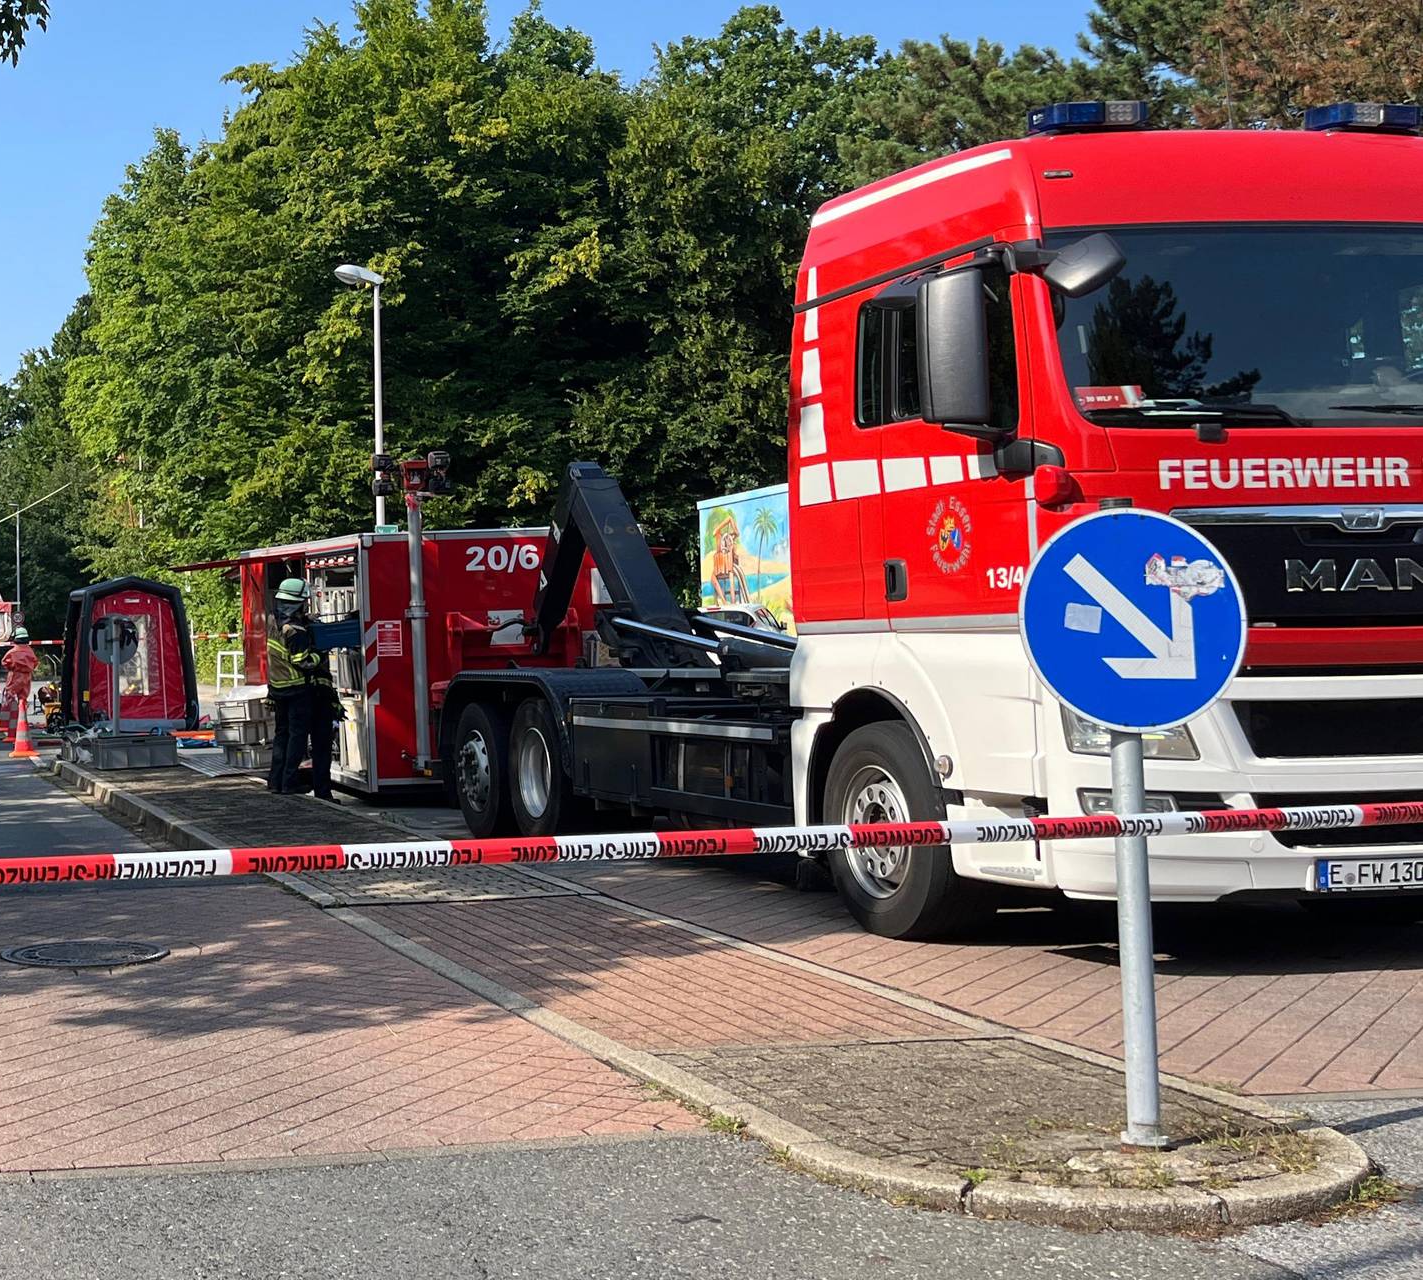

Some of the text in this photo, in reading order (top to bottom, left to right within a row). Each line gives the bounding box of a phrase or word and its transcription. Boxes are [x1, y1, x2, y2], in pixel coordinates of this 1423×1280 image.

[1159, 457, 1410, 490] FEUERWEHR
[949, 495, 972, 533] Essen
[465, 543, 541, 573] 20/6
[930, 541, 971, 574] Feuerwehr
[986, 566, 1024, 590] 13/4
[1330, 864, 1343, 885] E
[1358, 862, 1384, 884] FW
